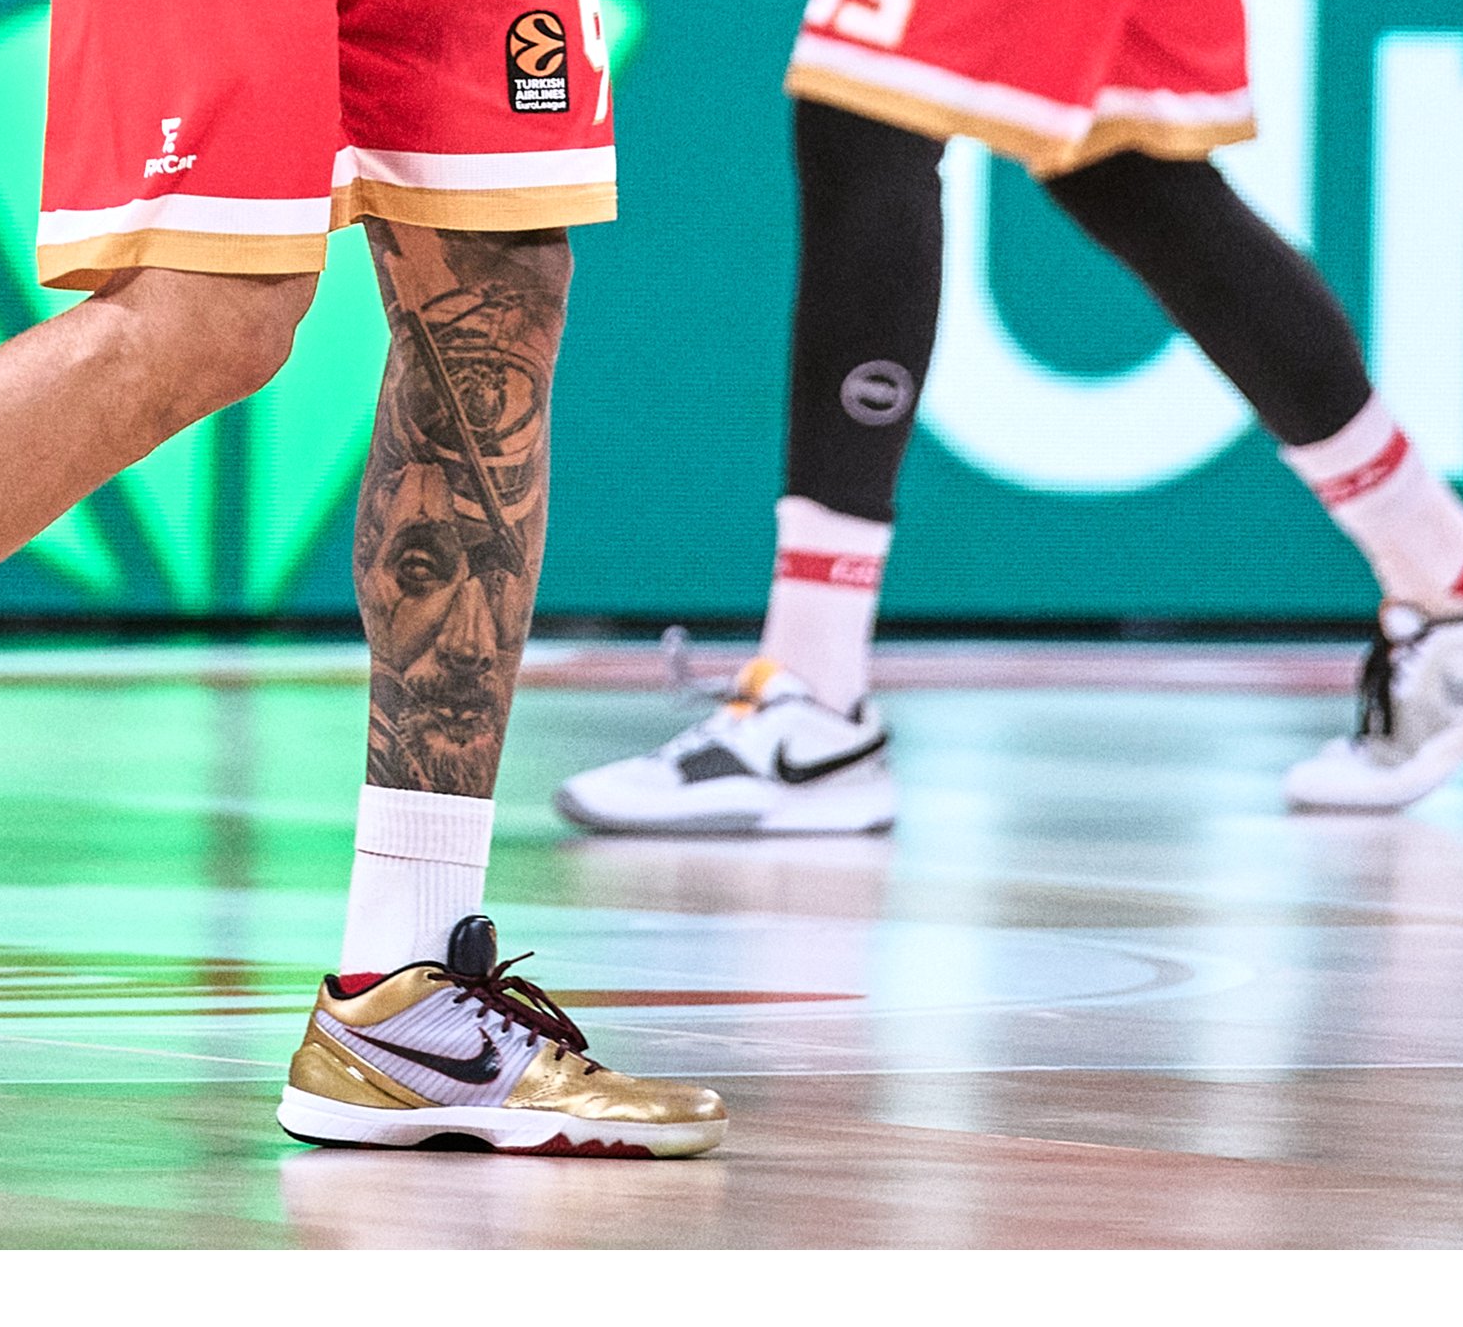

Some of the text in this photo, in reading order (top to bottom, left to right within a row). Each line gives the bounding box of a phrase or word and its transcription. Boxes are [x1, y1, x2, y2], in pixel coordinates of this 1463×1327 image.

[514, 78, 566, 90] TURKISH
[515, 89, 567, 101] AIRLINES
[515, 100, 568, 111] EuroLeague
